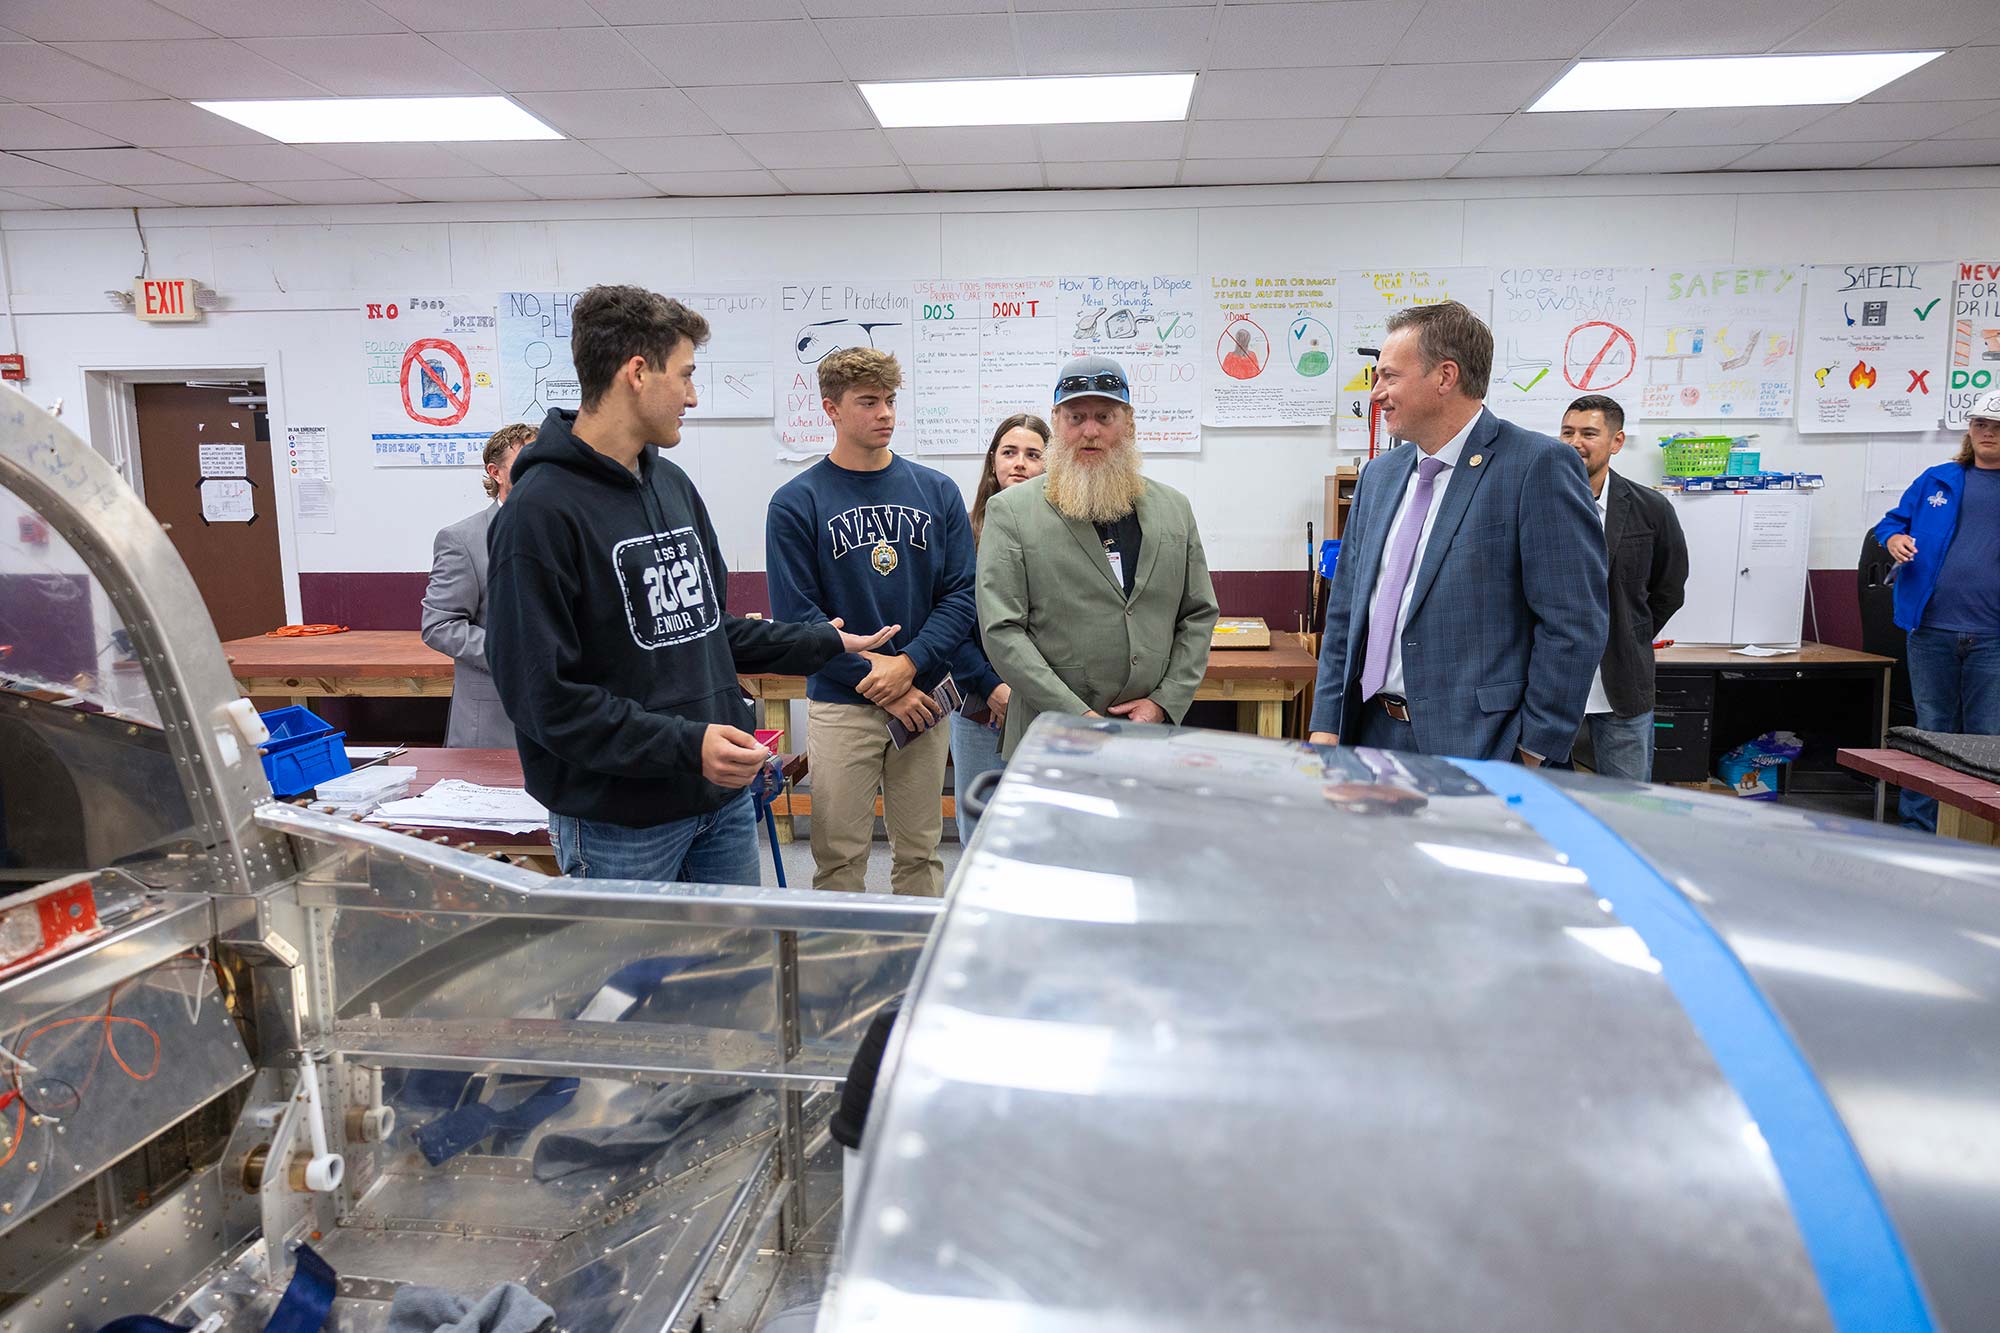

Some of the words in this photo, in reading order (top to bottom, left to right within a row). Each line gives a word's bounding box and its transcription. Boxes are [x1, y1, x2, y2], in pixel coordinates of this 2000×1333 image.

[1844, 265, 1919, 289] SAFETY
[1960, 262, 2000, 281] NEV
[913, 282, 935, 295] USE
[1107, 277, 1148, 297] Properly
[1153, 277, 1192, 297] Dispose
[1211, 277, 1247, 288] LONG
[1255, 278, 1287, 287] HAIR
[1290, 278, 1305, 286] OR
[1667, 269, 1796, 301] SAFETY
[144, 281, 184, 314] EXIT
[511, 293, 542, 317] NO
[782, 286, 833, 311] EYE
[1082, 294, 1104, 306] Metal
[367, 303, 399, 320] NO
[924, 303, 955, 320] DO'S
[993, 301, 1040, 319] DON'T
[1174, 324, 1196, 339] DO
[374, 355, 399, 367] THE
[368, 368, 400, 383] RULES
[1128, 363, 1165, 383] NOT
[1170, 362, 1195, 383] DO
[1952, 370, 1992, 390] DO
[788, 394, 816, 411] EYE
[428, 442, 457, 453] THE
[420, 452, 465, 464] LINE
[828, 504, 932, 560] NAVY
